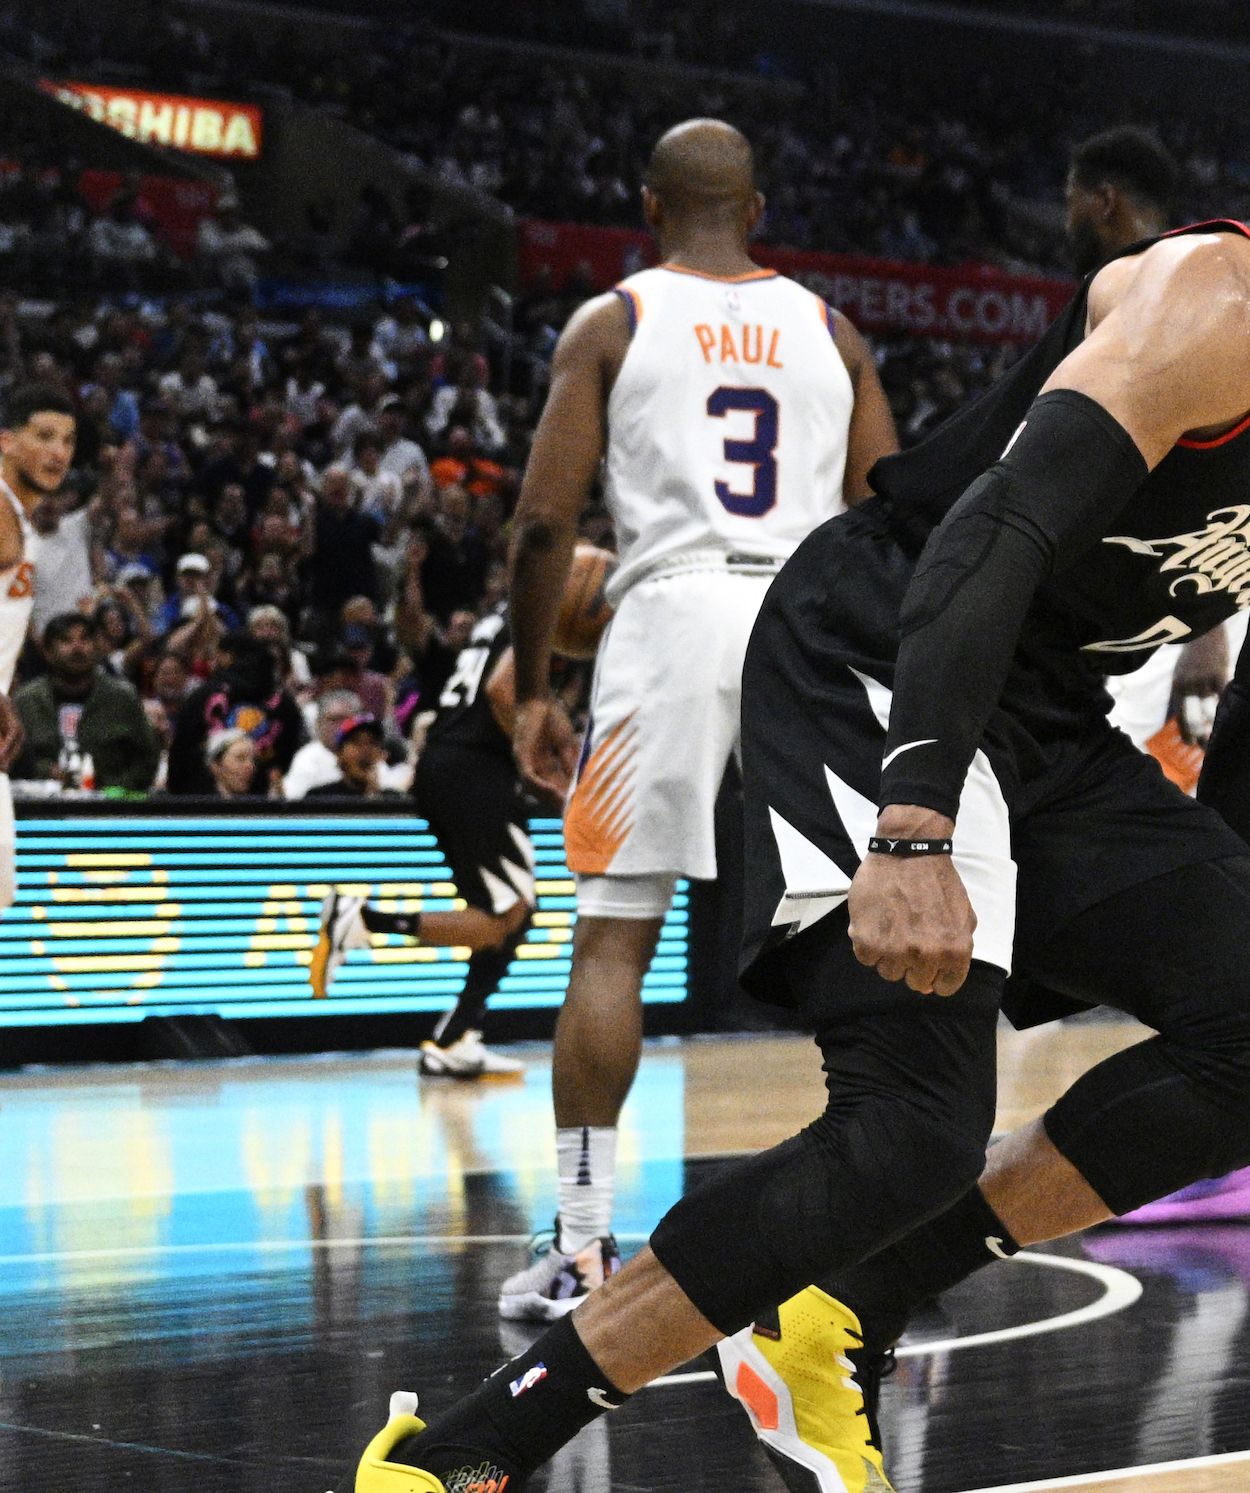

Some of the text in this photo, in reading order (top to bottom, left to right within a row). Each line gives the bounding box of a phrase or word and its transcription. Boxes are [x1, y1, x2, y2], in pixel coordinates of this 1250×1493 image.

[694, 324, 784, 369] PAUL
[706, 385, 780, 519] 3
[439, 646, 490, 707] 24
